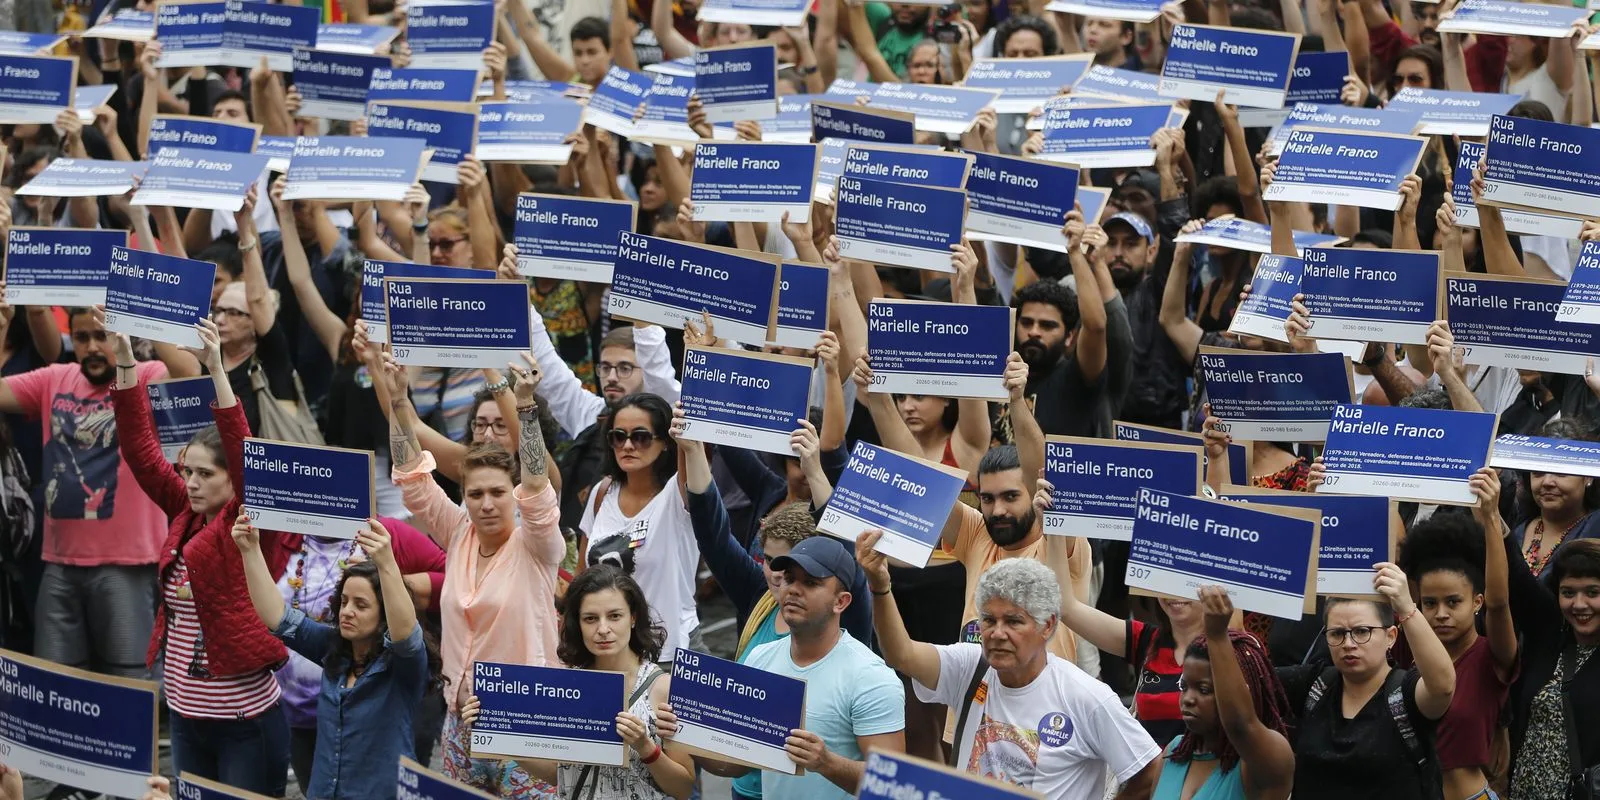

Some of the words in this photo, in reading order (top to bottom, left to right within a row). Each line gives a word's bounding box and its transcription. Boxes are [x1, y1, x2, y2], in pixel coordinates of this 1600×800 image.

[1173, 28, 1196, 37] Rua
[1170, 36, 1217, 52] Marielle
[1220, 42, 1258, 56] Franco
[695, 52, 709, 63] Rua
[4, 66, 40, 78] Franco
[372, 68, 392, 79] Rua
[695, 61, 722, 75] Marielle
[724, 62, 751, 72] Franco
[369, 78, 409, 90] Marielle
[410, 79, 445, 90] Franco
[370, 104, 389, 116] Rua
[813, 105, 832, 118] Rua
[1048, 109, 1071, 119] Rua
[1293, 102, 1319, 113] Rua
[368, 114, 403, 129] Marielle
[406, 119, 441, 133] Franco
[1045, 117, 1087, 130] Marielle
[1089, 118, 1132, 127] Franco
[1289, 110, 1337, 125] Marielle
[1339, 115, 1381, 126] Franco
[1493, 116, 1514, 130] Rua
[812, 116, 850, 132] Marielle
[852, 123, 885, 139] Franco
[182, 131, 217, 145] Franco
[296, 136, 319, 146] Rua
[1290, 130, 1314, 142] Rua
[1490, 130, 1536, 148] Marielle
[1540, 138, 1582, 154] Franco
[158, 148, 179, 158] Rua
[294, 145, 340, 156] Marielle
[343, 147, 385, 157] Franco
[695, 144, 718, 156] Rua
[848, 148, 870, 161] Rua
[1285, 142, 1334, 155] Marielle
[1336, 146, 1378, 158] Franco
[1461, 144, 1487, 156] Rua
[152, 156, 194, 168] Marielle
[195, 160, 232, 171] Franco
[694, 157, 738, 169] Marielle
[742, 158, 780, 169] Franco
[845, 161, 889, 175] Marielle
[892, 165, 928, 179] Franco
[840, 177, 864, 190] Rua
[999, 171, 1038, 188] Franco
[1268, 186, 1285, 194] 307
[517, 196, 537, 209] Rua
[839, 190, 883, 207] Marielle
[887, 199, 926, 213] Franco
[516, 210, 558, 224] Marielle
[561, 214, 598, 227] Franco
[9, 231, 31, 242] Rua
[619, 232, 648, 249] Rua
[8, 243, 51, 254] Marielle
[54, 244, 91, 255] Franco
[112, 248, 128, 261] Rua
[1305, 249, 1326, 262] Rua
[364, 260, 384, 273] Rua
[619, 246, 675, 268] Marielle
[680, 260, 729, 280] Franco
[1261, 255, 1280, 267] Rua
[110, 262, 144, 278] Marielle
[147, 268, 180, 285] Franco
[1255, 267, 1294, 285] Marielle
[1304, 264, 1350, 278] Marielle
[1354, 267, 1397, 281] Franco
[389, 282, 412, 294] Rua
[1449, 280, 1477, 292] Rua
[390, 296, 438, 309] Marielle
[442, 298, 486, 310] Franco
[611, 298, 631, 309] 307
[1450, 294, 1508, 309] Marielle
[1513, 298, 1561, 312] Franco
[870, 304, 893, 317] Rua
[1560, 306, 1581, 315] 307
[870, 319, 920, 333] Marielle
[925, 321, 969, 335] Franco
[394, 349, 410, 358] 307
[686, 351, 706, 365] Rua
[1201, 356, 1226, 368] Rua
[685, 365, 726, 386] Marielle
[730, 372, 770, 389] Franco
[1204, 370, 1254, 383] Marielle
[1257, 371, 1303, 383] Franco
[174, 396, 201, 408] Franco
[1335, 406, 1362, 418] Rua
[1116, 425, 1140, 440] Rua
[1331, 420, 1389, 435] Marielle
[1394, 424, 1444, 438] Franco
[244, 442, 265, 455] Rua
[1494, 438, 1542, 449] Marielle
[853, 442, 877, 460] Rua
[1047, 444, 1072, 457] Rua
[244, 456, 288, 473] Marielle
[293, 462, 332, 478] Franco
[1047, 459, 1101, 475] Marielle
[1107, 463, 1153, 479] Franco
[847, 457, 890, 483] Marielle
[891, 474, 926, 497] Franco
[1140, 489, 1171, 507] Rua
[823, 512, 841, 524] 307
[1045, 517, 1064, 527] 307
[1138, 506, 1199, 530] Marielle
[1204, 519, 1259, 542] Franco
[633, 520, 649, 530] ELE
[631, 529, 647, 541] NÃO
[1129, 567, 1151, 579] 307
[676, 649, 699, 666] Rua
[476, 663, 501, 677] Rua
[475, 678, 529, 695] Marielle
[535, 683, 581, 699] Franco
[674, 664, 722, 688] Marielle
[726, 678, 766, 700] Franco
[49, 691, 100, 717] Franco
[473, 735, 493, 745] 307
[1040, 728, 1070, 740] MARIELLE
[1046, 737, 1060, 745] VIVE
[179, 781, 201, 800] Rua
